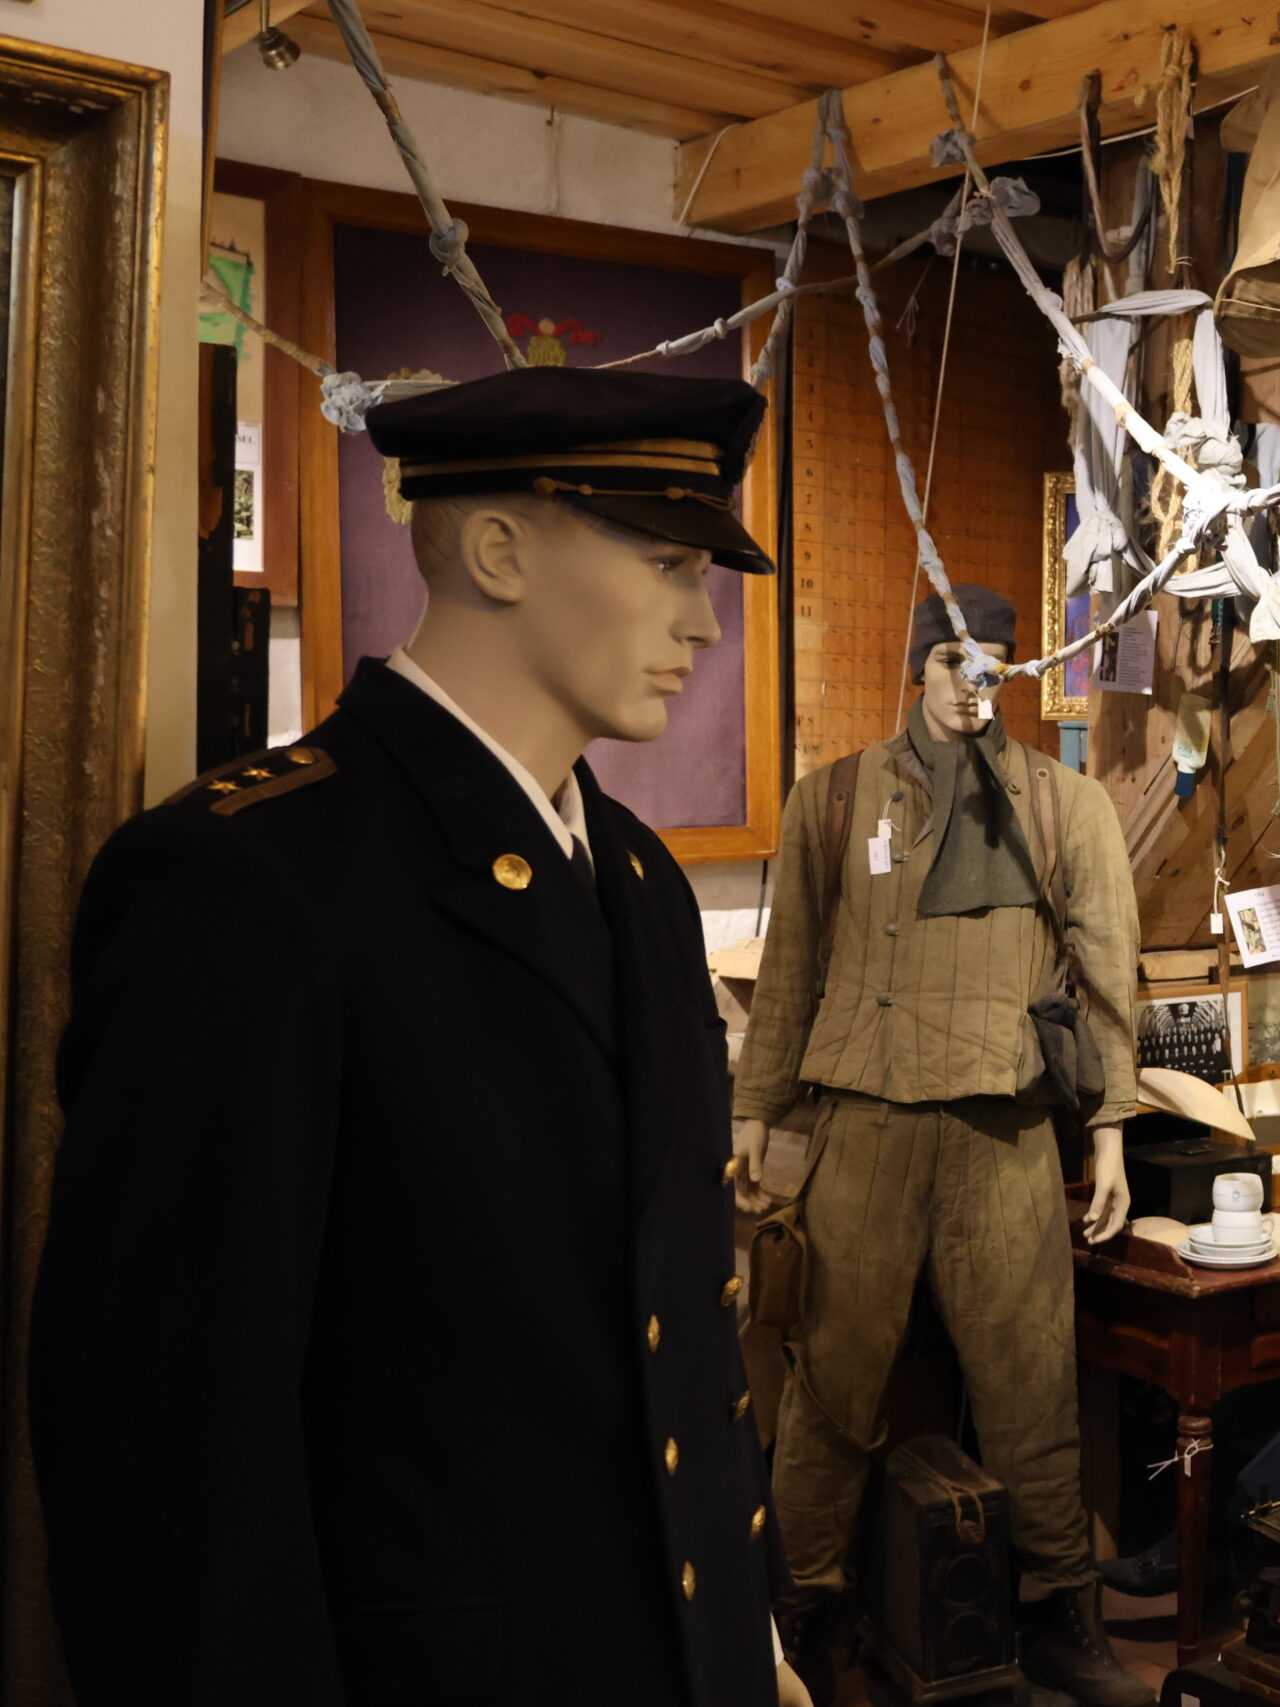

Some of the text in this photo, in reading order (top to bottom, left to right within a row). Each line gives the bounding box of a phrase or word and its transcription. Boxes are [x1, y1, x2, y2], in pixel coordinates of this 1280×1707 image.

[806, 439, 814, 450] 5
[805, 467, 814, 478] 6
[803, 551, 811, 561] 9
[800, 577, 814, 589] 10
[800, 605, 812, 617] 11
